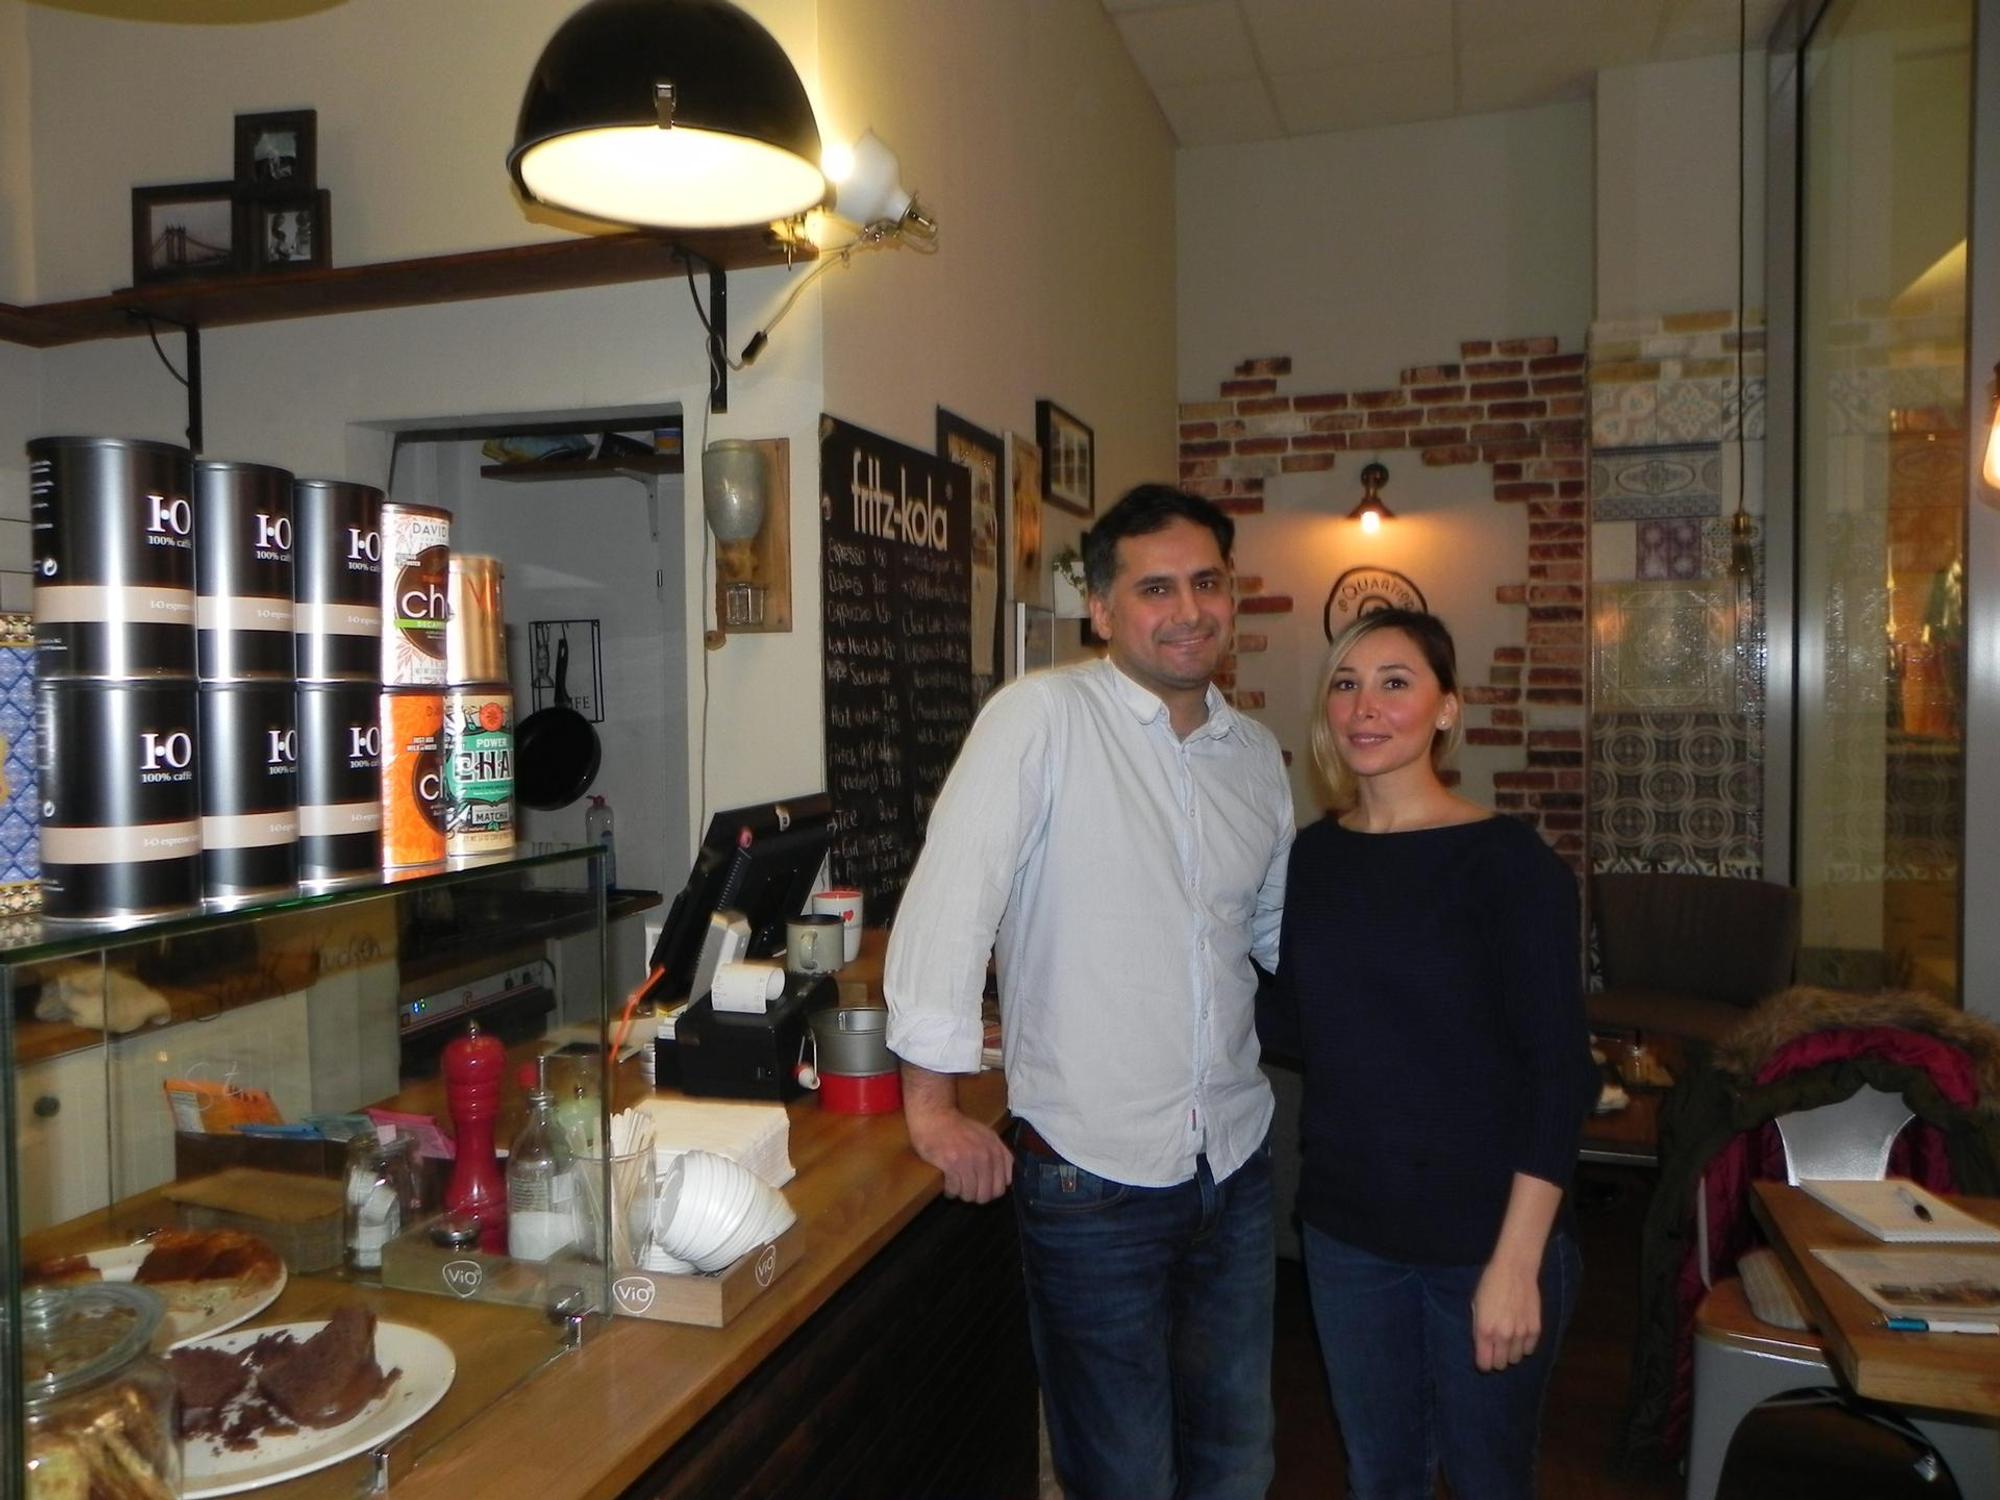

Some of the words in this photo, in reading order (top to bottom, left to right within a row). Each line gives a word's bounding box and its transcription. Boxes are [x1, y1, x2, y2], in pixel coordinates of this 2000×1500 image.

[851, 448, 949, 552] fritz-kola
[148, 536, 175, 547] 100%
[256, 550, 279, 561] 100%
[476, 738, 507, 748] POWER
[141, 773, 171, 784] 100%
